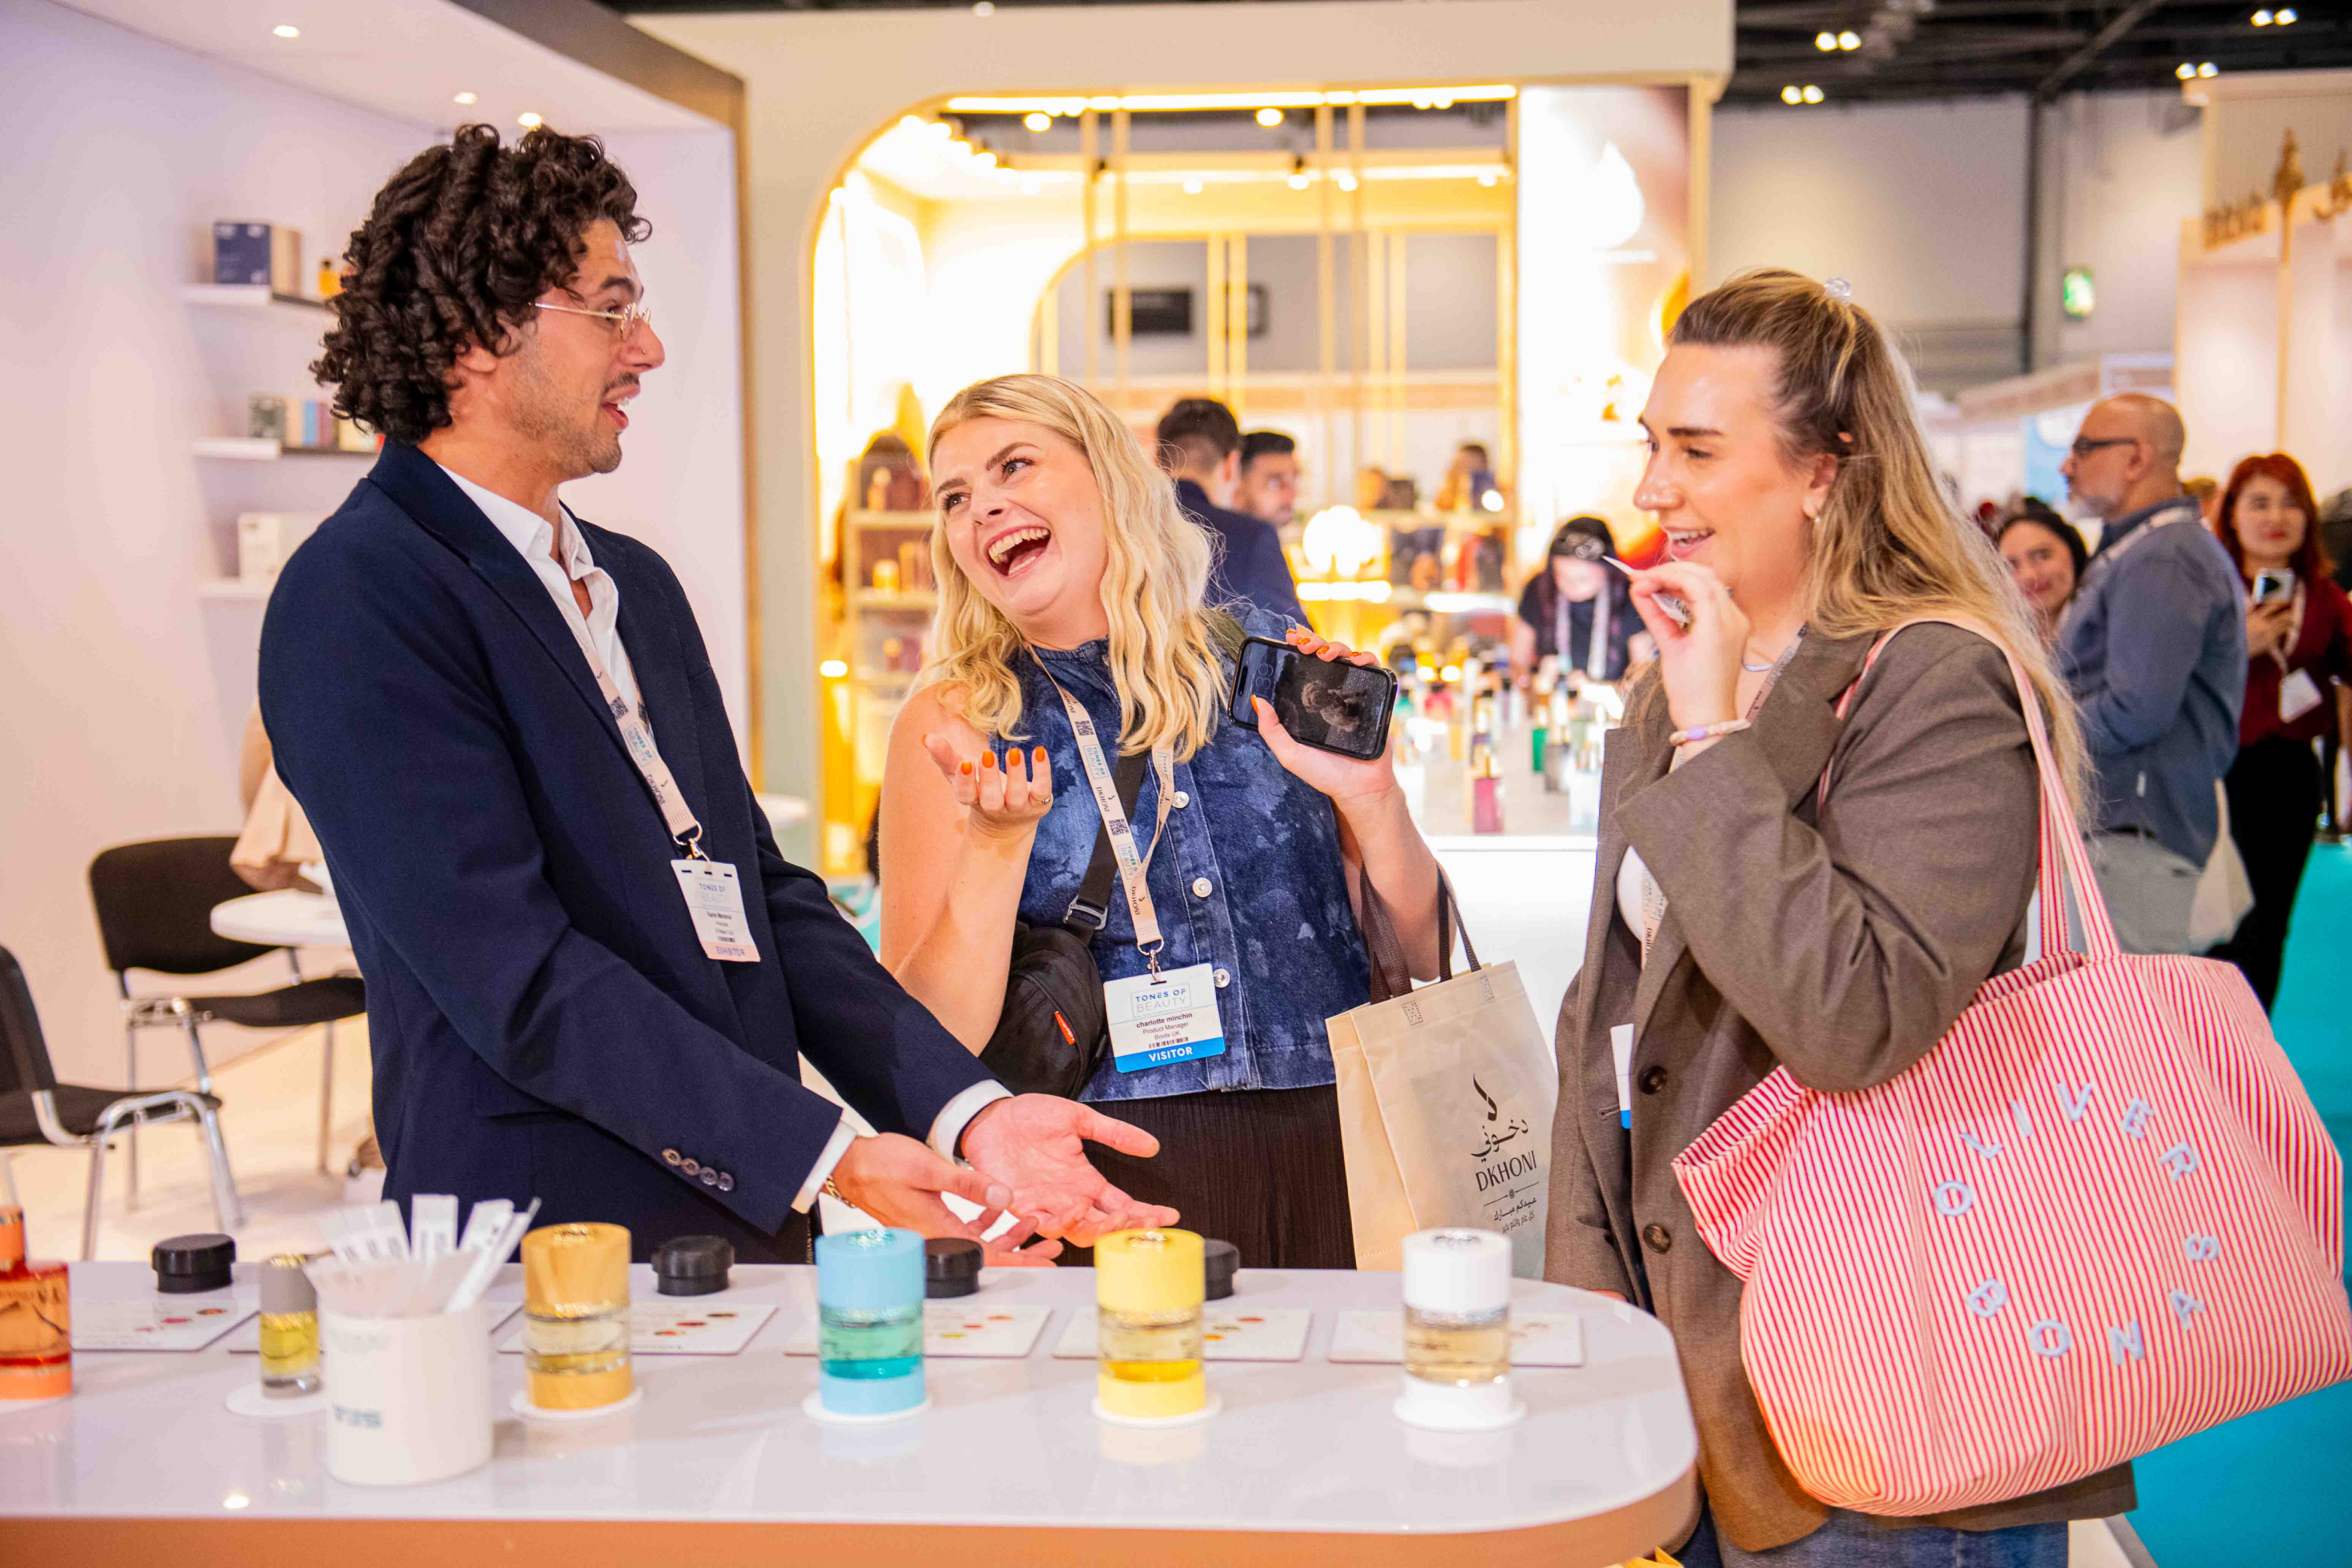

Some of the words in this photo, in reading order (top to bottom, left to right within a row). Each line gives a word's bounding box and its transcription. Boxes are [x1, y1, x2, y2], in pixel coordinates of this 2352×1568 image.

[1096, 787, 1110, 812] DKHONI
[1131, 886, 1141, 915] DKHONI
[1135, 991, 1169, 1003] TONES
[1136, 996, 1187, 1013] BEAUTY
[1136, 1018, 1165, 1028] charlotte
[1166, 1013, 1193, 1022] minchin
[1142, 1026, 1164, 1035] Product
[1165, 1021, 1189, 1030] Manager
[1148, 1046, 1193, 1062] VISITOR
[1470, 1118, 1529, 1163] دخوني
[1934, 1083, 2198, 1217] OLIVER
[1475, 1150, 1537, 1192] DKHONI
[1516, 1197, 1537, 1215] عيدكم
